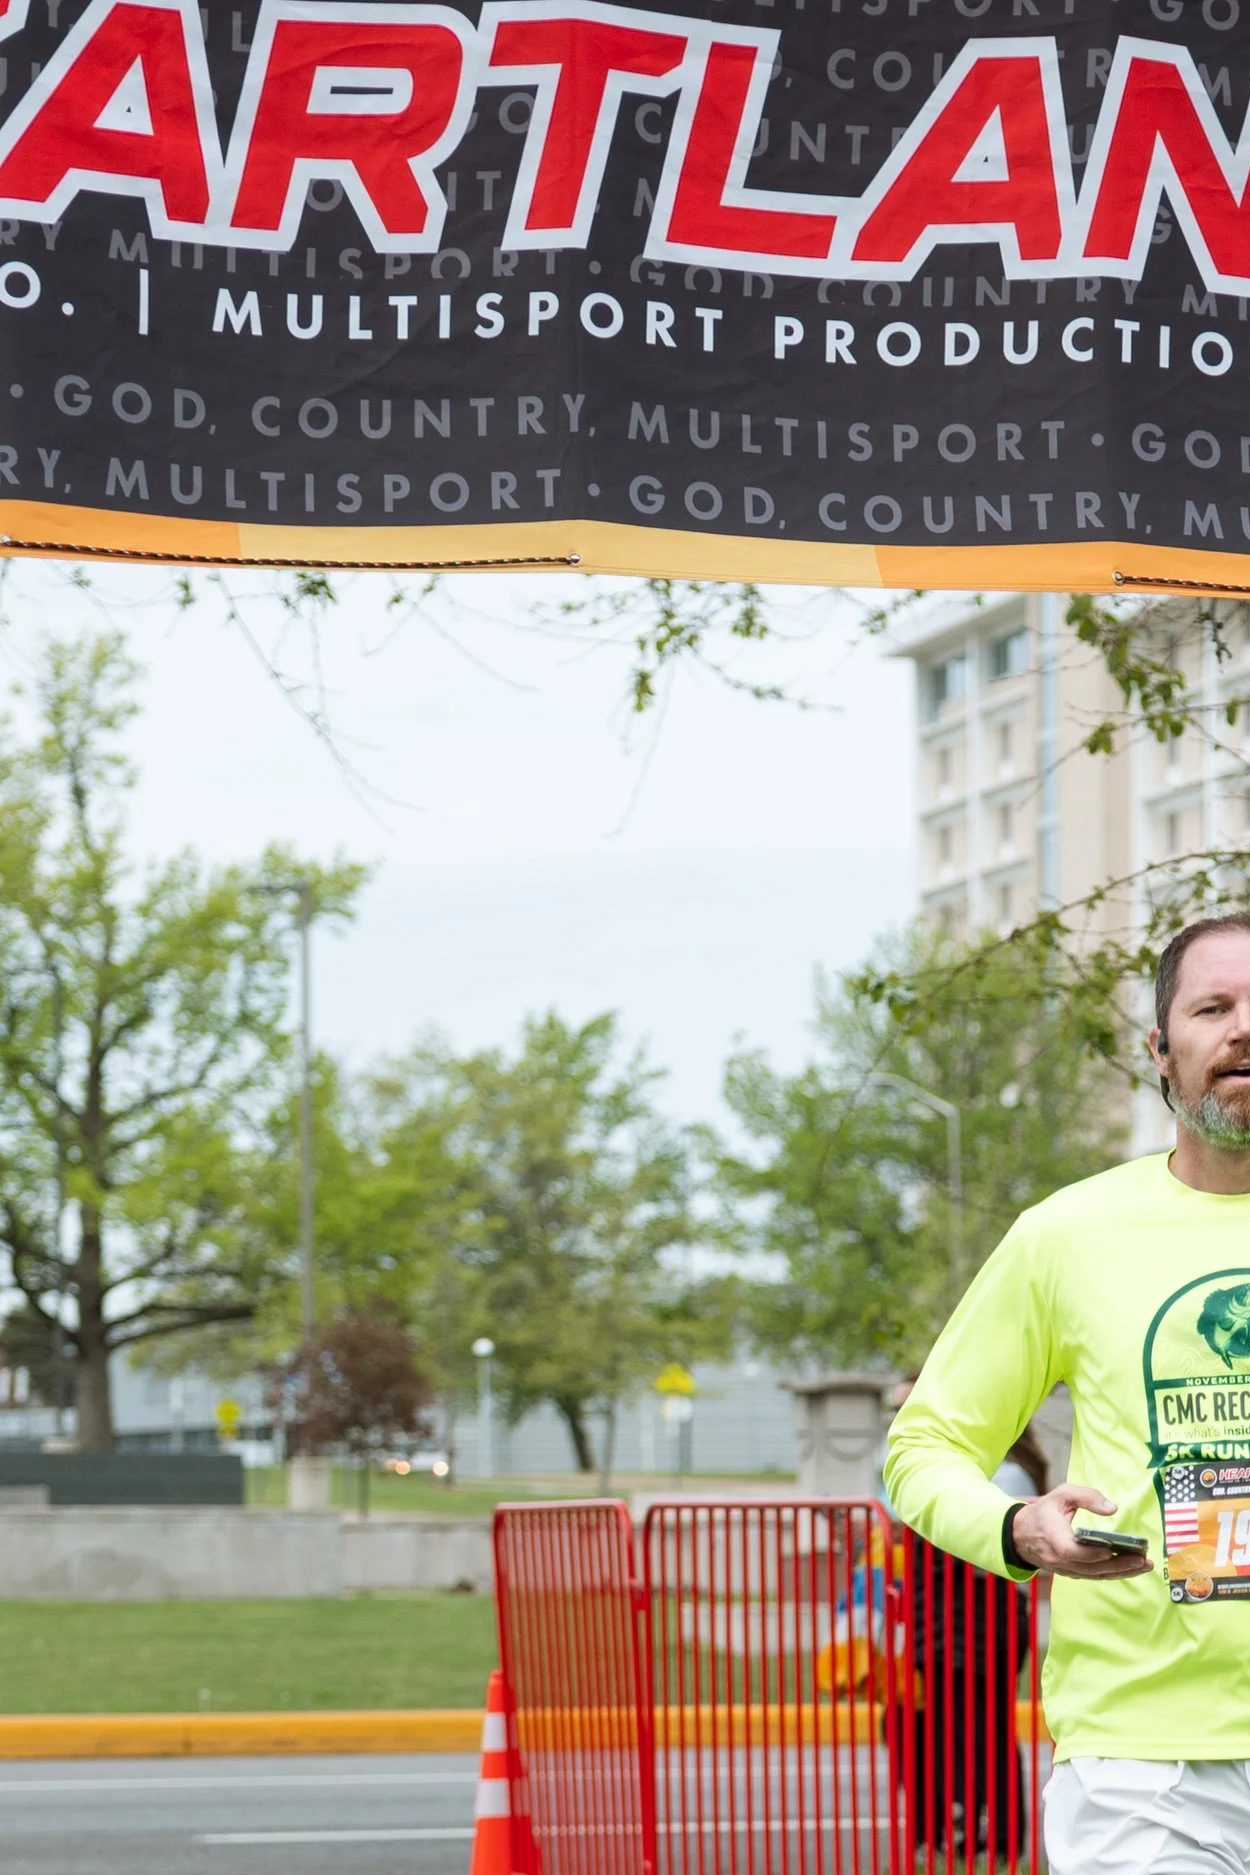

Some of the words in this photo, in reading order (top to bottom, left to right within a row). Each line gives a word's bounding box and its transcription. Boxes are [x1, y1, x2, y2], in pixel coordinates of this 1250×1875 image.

[212, 288, 723, 352] MULTISPORT
[54, 374, 217, 435] GOD,
[251, 393, 595, 438] COUNTRY,
[628, 401, 1066, 462] MULTISPORT
[105, 457, 562, 513] MULTISPORT
[628, 474, 786, 529] GOD,
[819, 491, 1152, 535] COUNTRY,
[1163, 1392, 1208, 1425] CMC
[1184, 1427, 1220, 1438] what's
[1165, 1443, 1195, 1461] 5K
